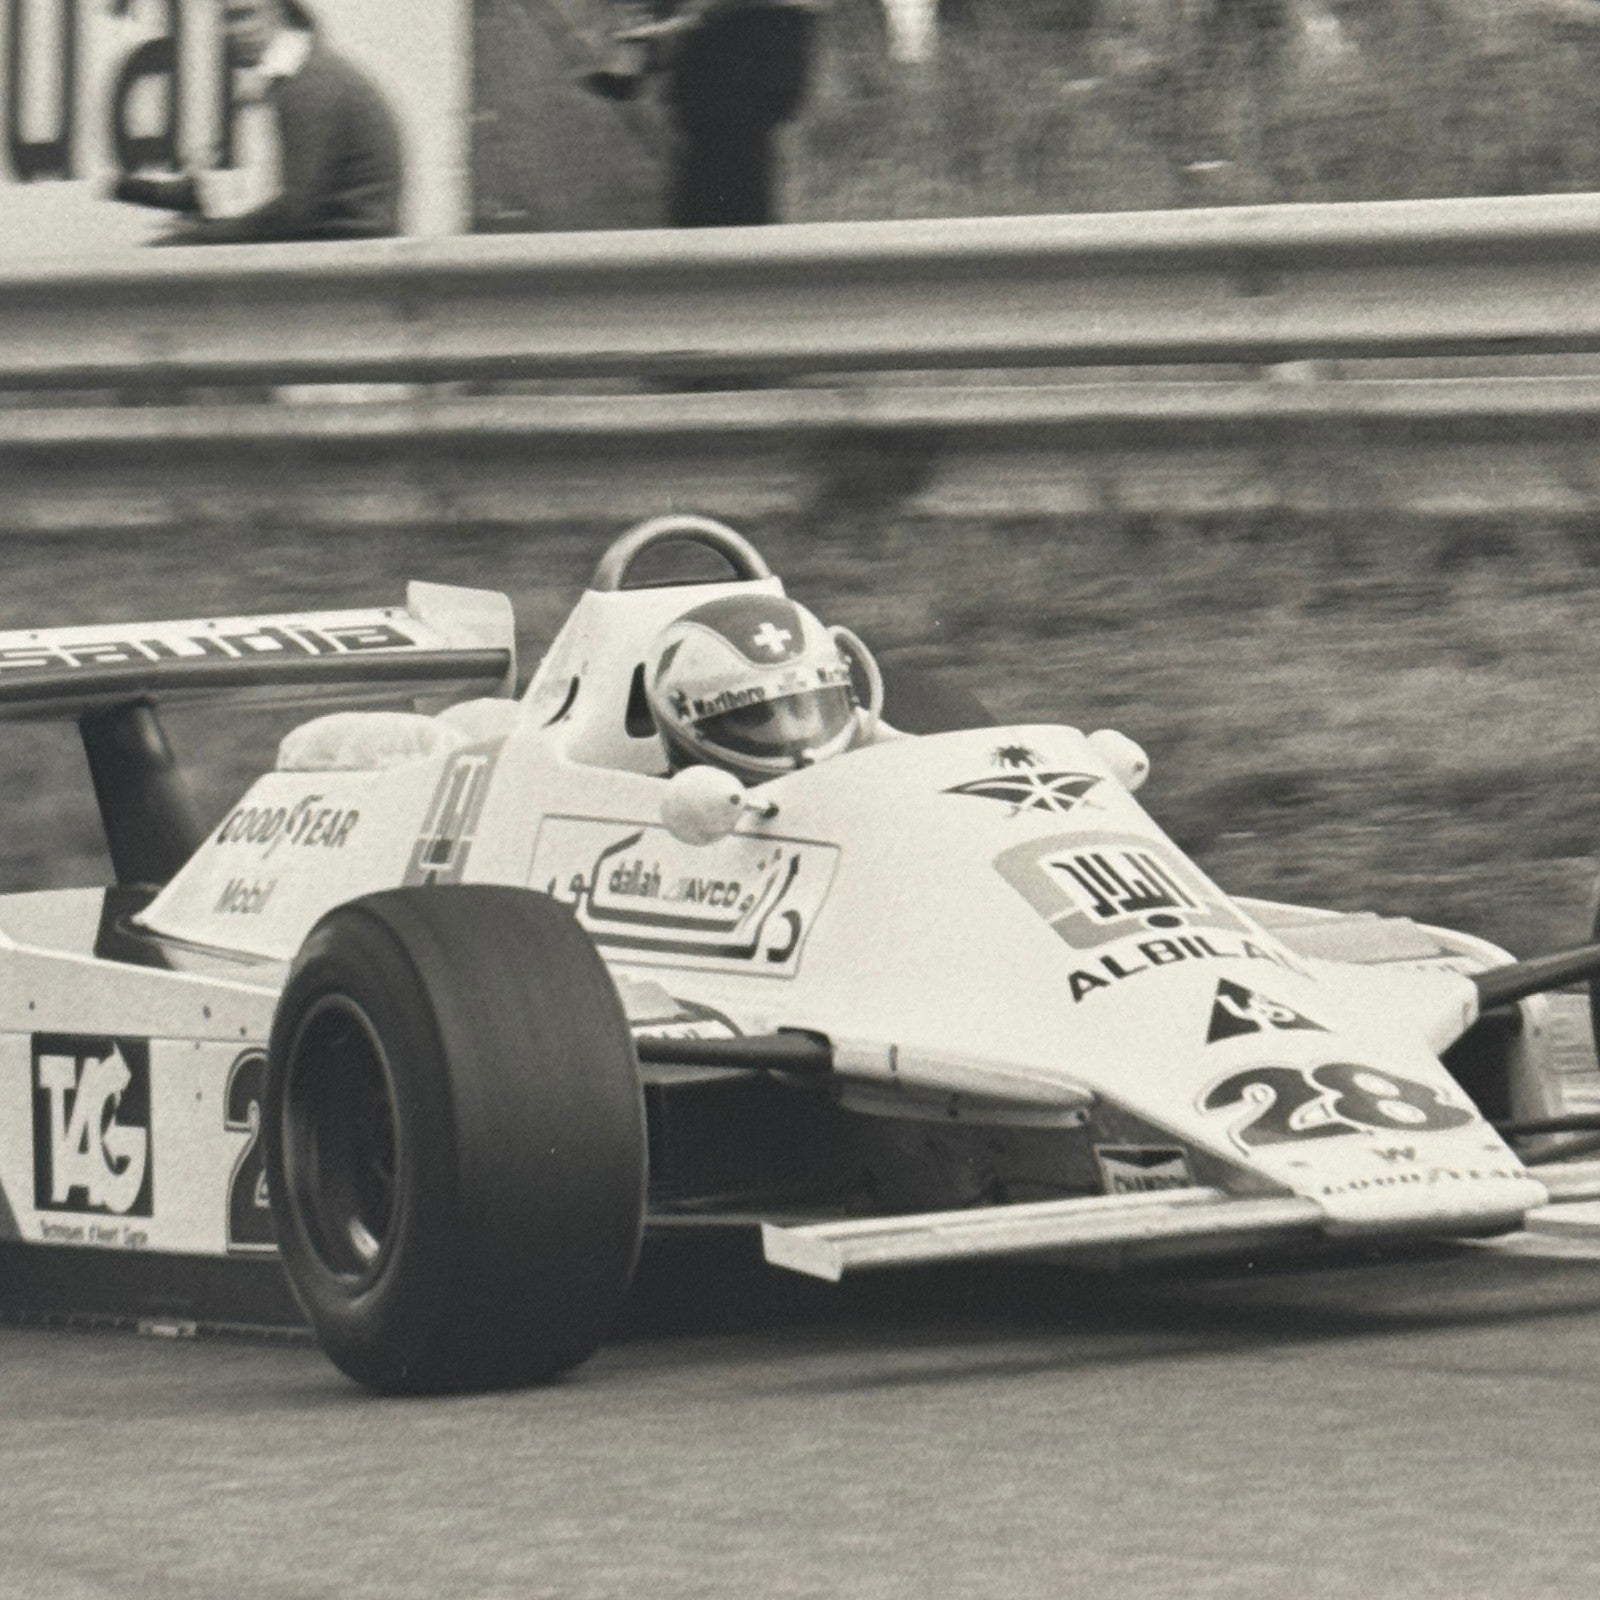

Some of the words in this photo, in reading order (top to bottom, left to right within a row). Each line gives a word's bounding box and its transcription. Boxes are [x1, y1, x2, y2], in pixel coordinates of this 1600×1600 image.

[213, 878, 278, 914] Mobil
[38, 1040, 148, 1214] TAG
[1197, 1060, 1476, 1157] 28
